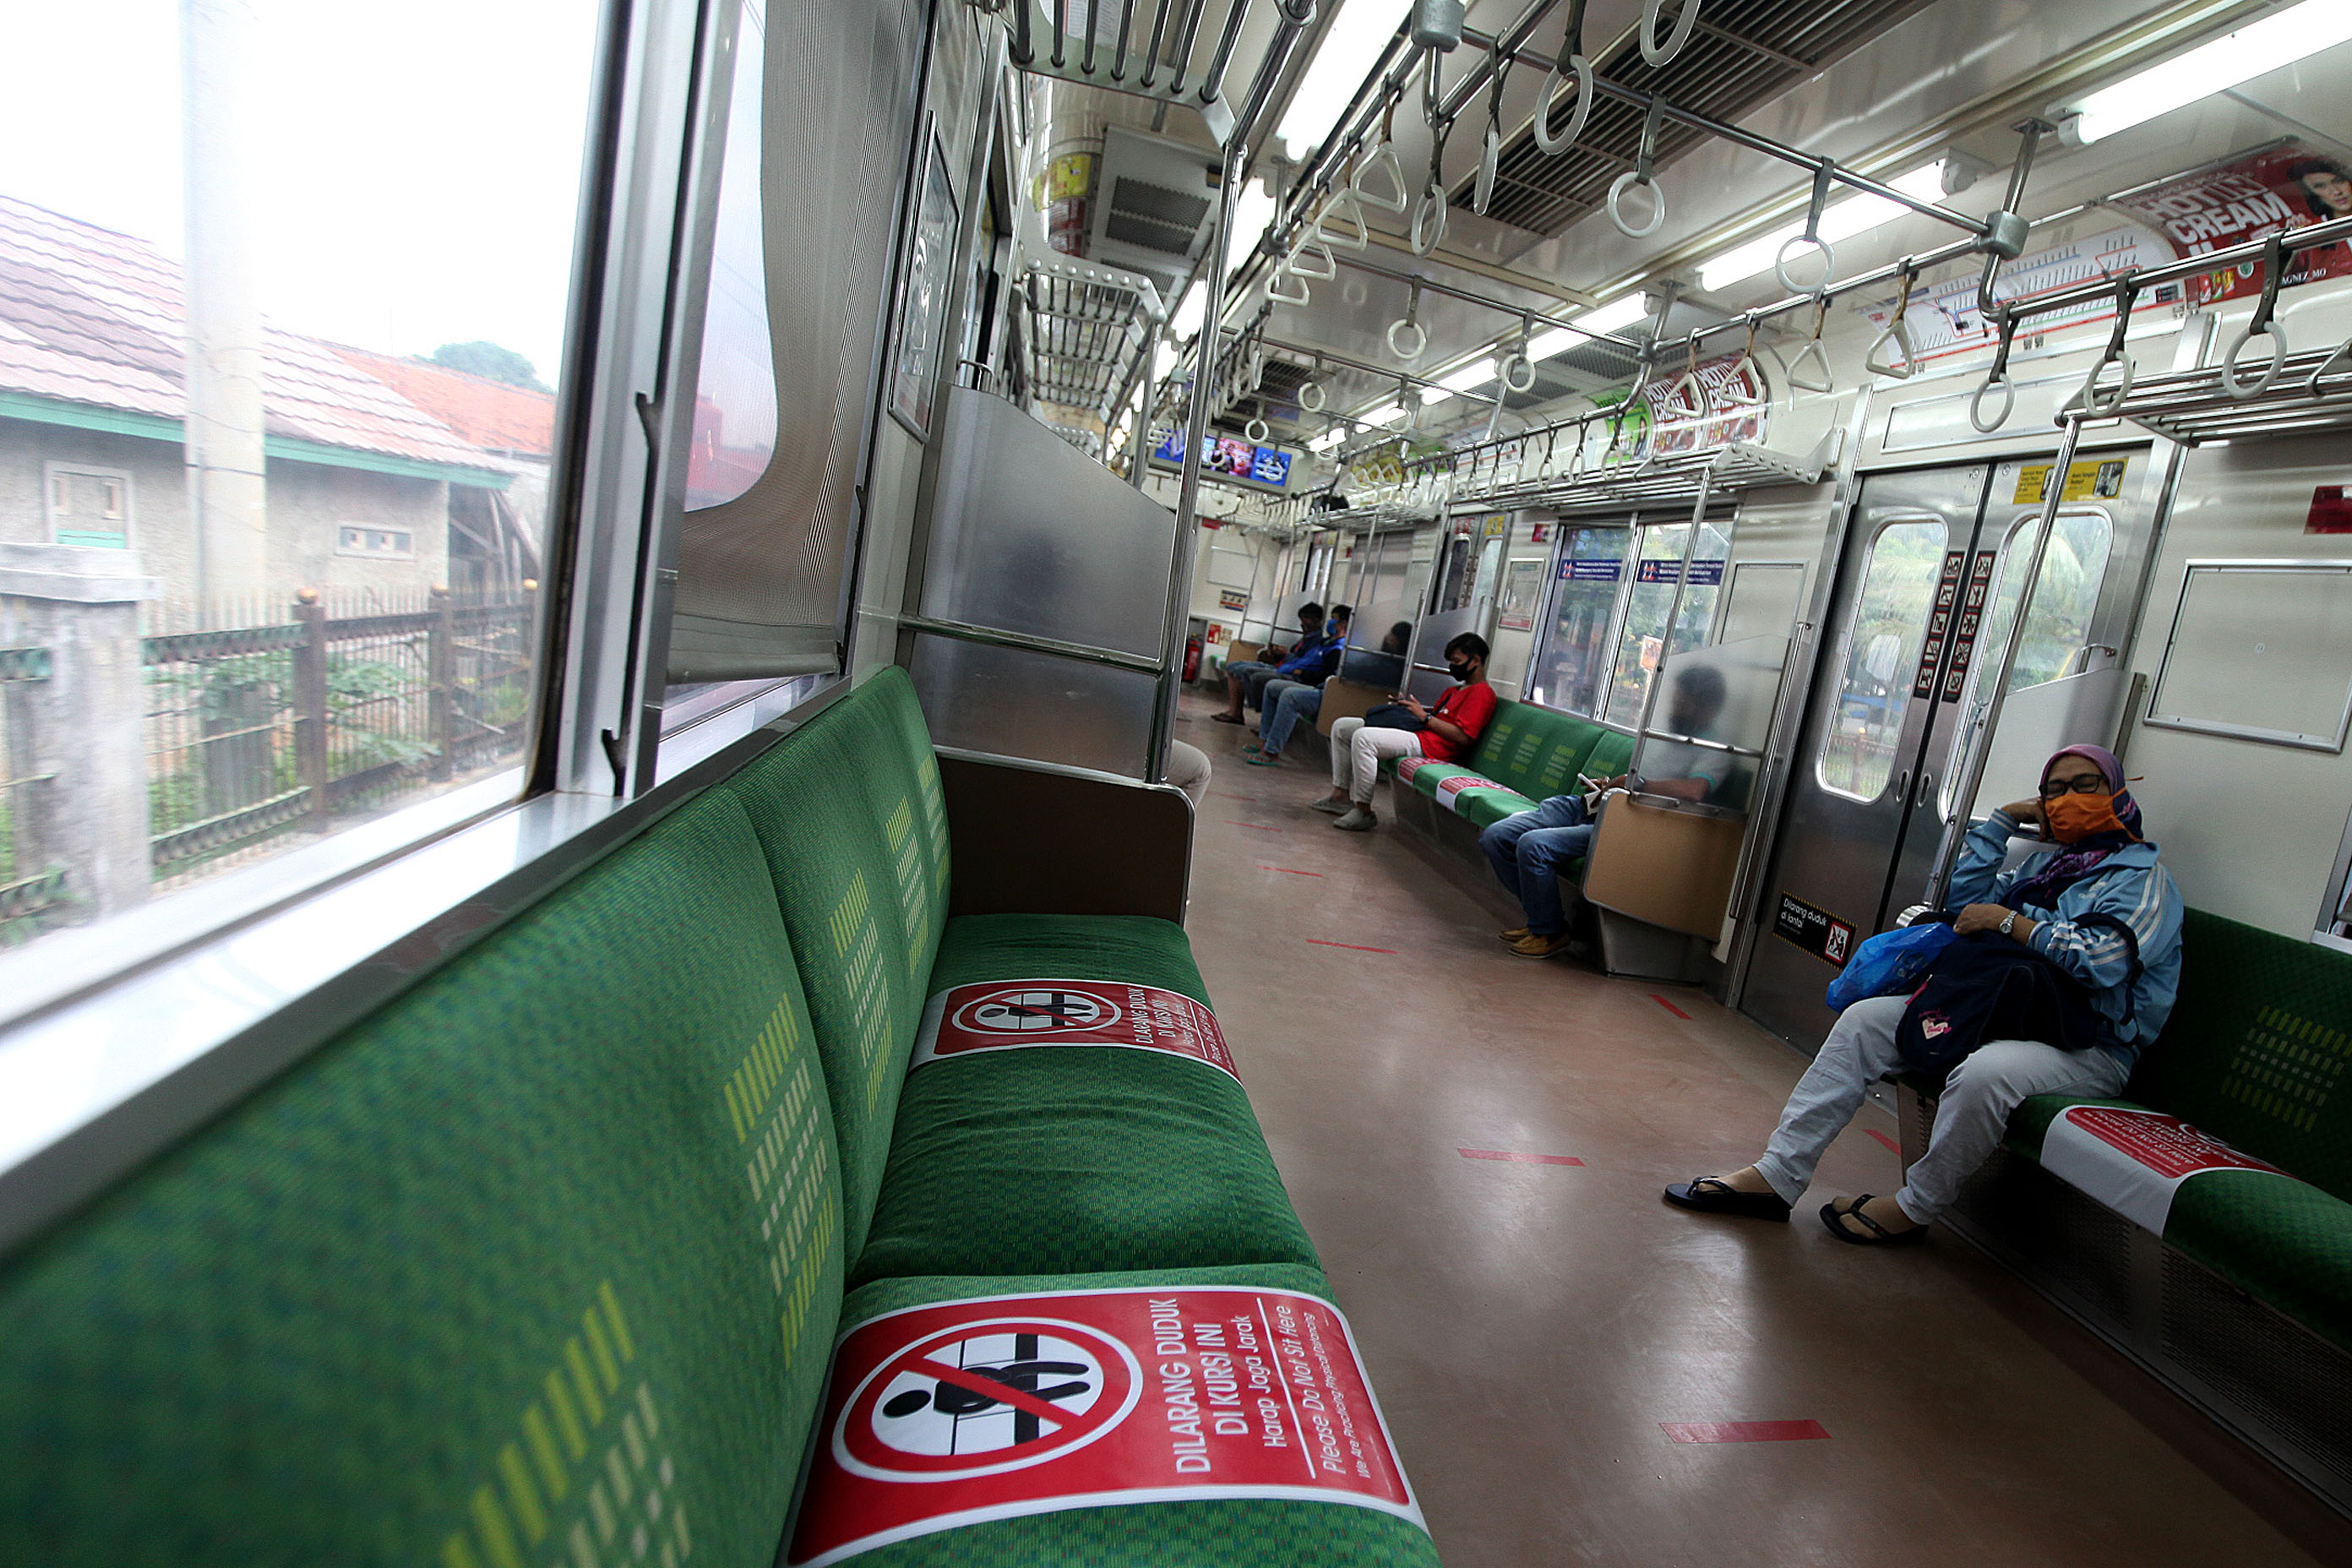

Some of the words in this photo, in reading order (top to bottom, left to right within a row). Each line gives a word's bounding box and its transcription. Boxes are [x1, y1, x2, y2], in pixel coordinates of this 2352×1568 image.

[2165, 191, 2293, 244] CREAM
[1149, 1298, 1187, 1355] DUDUK
[1193, 1323, 1226, 1347] INI
[1230, 1315, 1259, 1353] Jarak
[1277, 1305, 1298, 1337] Here
[1282, 1337, 1305, 1358] Sit
[1200, 1352, 1241, 1406] KURSI
[1244, 1355, 1271, 1394] Jaga
[1288, 1359, 1315, 1388] Not
[1315, 1353, 1339, 1391] Physical
[1158, 1362, 1211, 1473] DILARANG
[1302, 1389, 1326, 1412] Do
[1331, 1390, 1357, 1439] Practicing
[1212, 1411, 1249, 1435] DI
[1257, 1396, 1288, 1448] Harap
[1312, 1415, 1347, 1474] Please
[1349, 1439, 1364, 1460] Are
[1356, 1460, 1372, 1479] We
